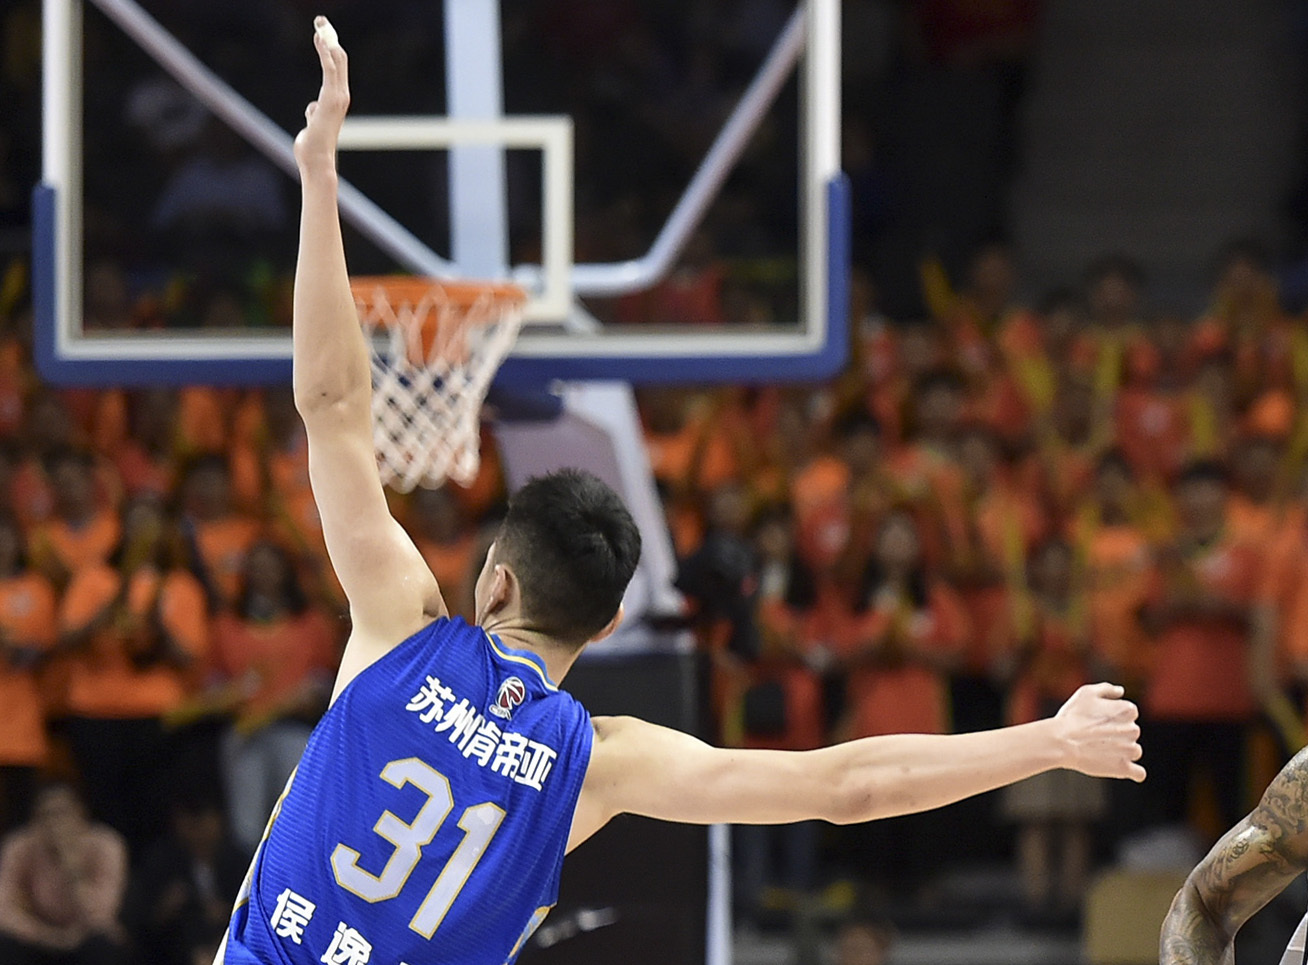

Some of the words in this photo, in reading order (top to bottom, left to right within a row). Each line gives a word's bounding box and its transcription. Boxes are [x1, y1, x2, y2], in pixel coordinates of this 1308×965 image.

[405, 674, 558, 792] 苏州肯帝亚
[329, 756, 507, 941] 31
